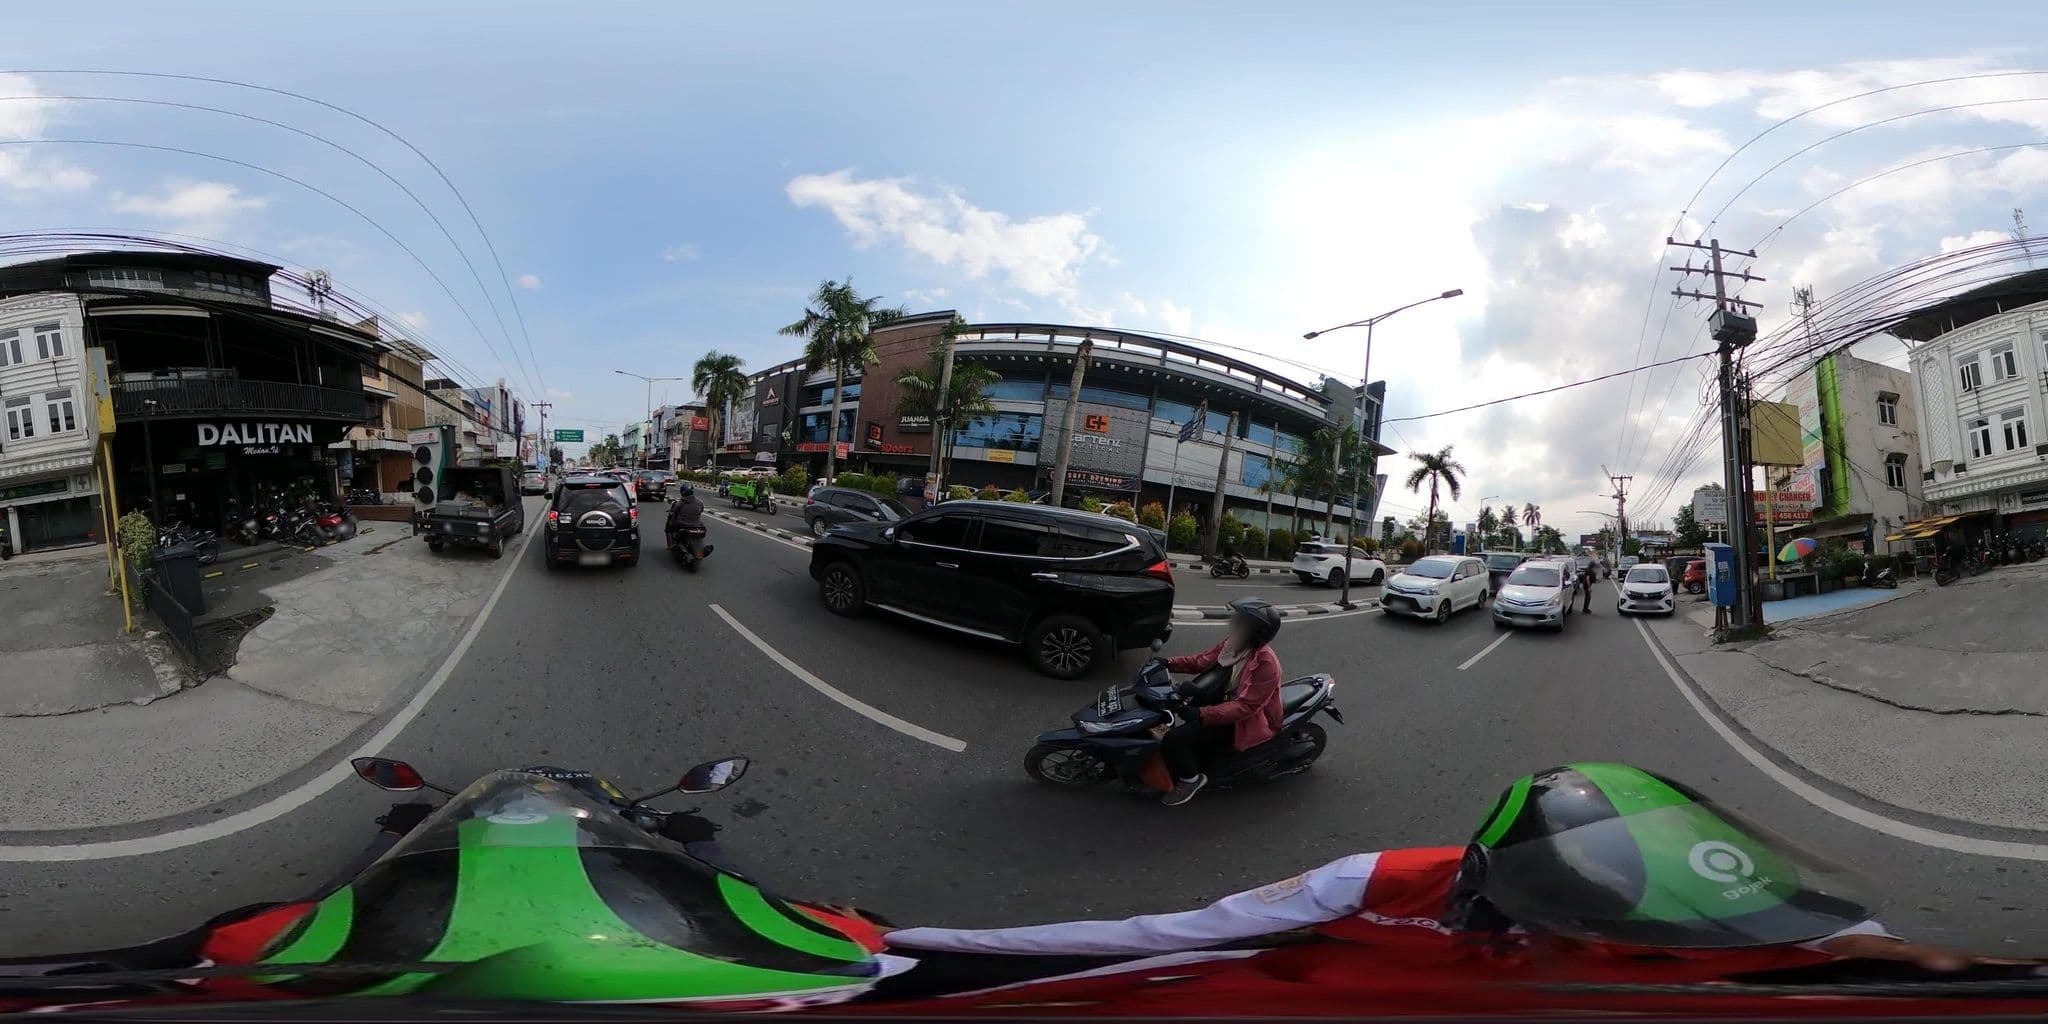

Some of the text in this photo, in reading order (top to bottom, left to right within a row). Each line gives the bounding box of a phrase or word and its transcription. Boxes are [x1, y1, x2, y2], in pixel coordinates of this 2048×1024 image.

[901, 416, 929, 424] JUANDA
[197, 424, 313, 445] DALITAN
[1722, 876, 1772, 900] gojek
